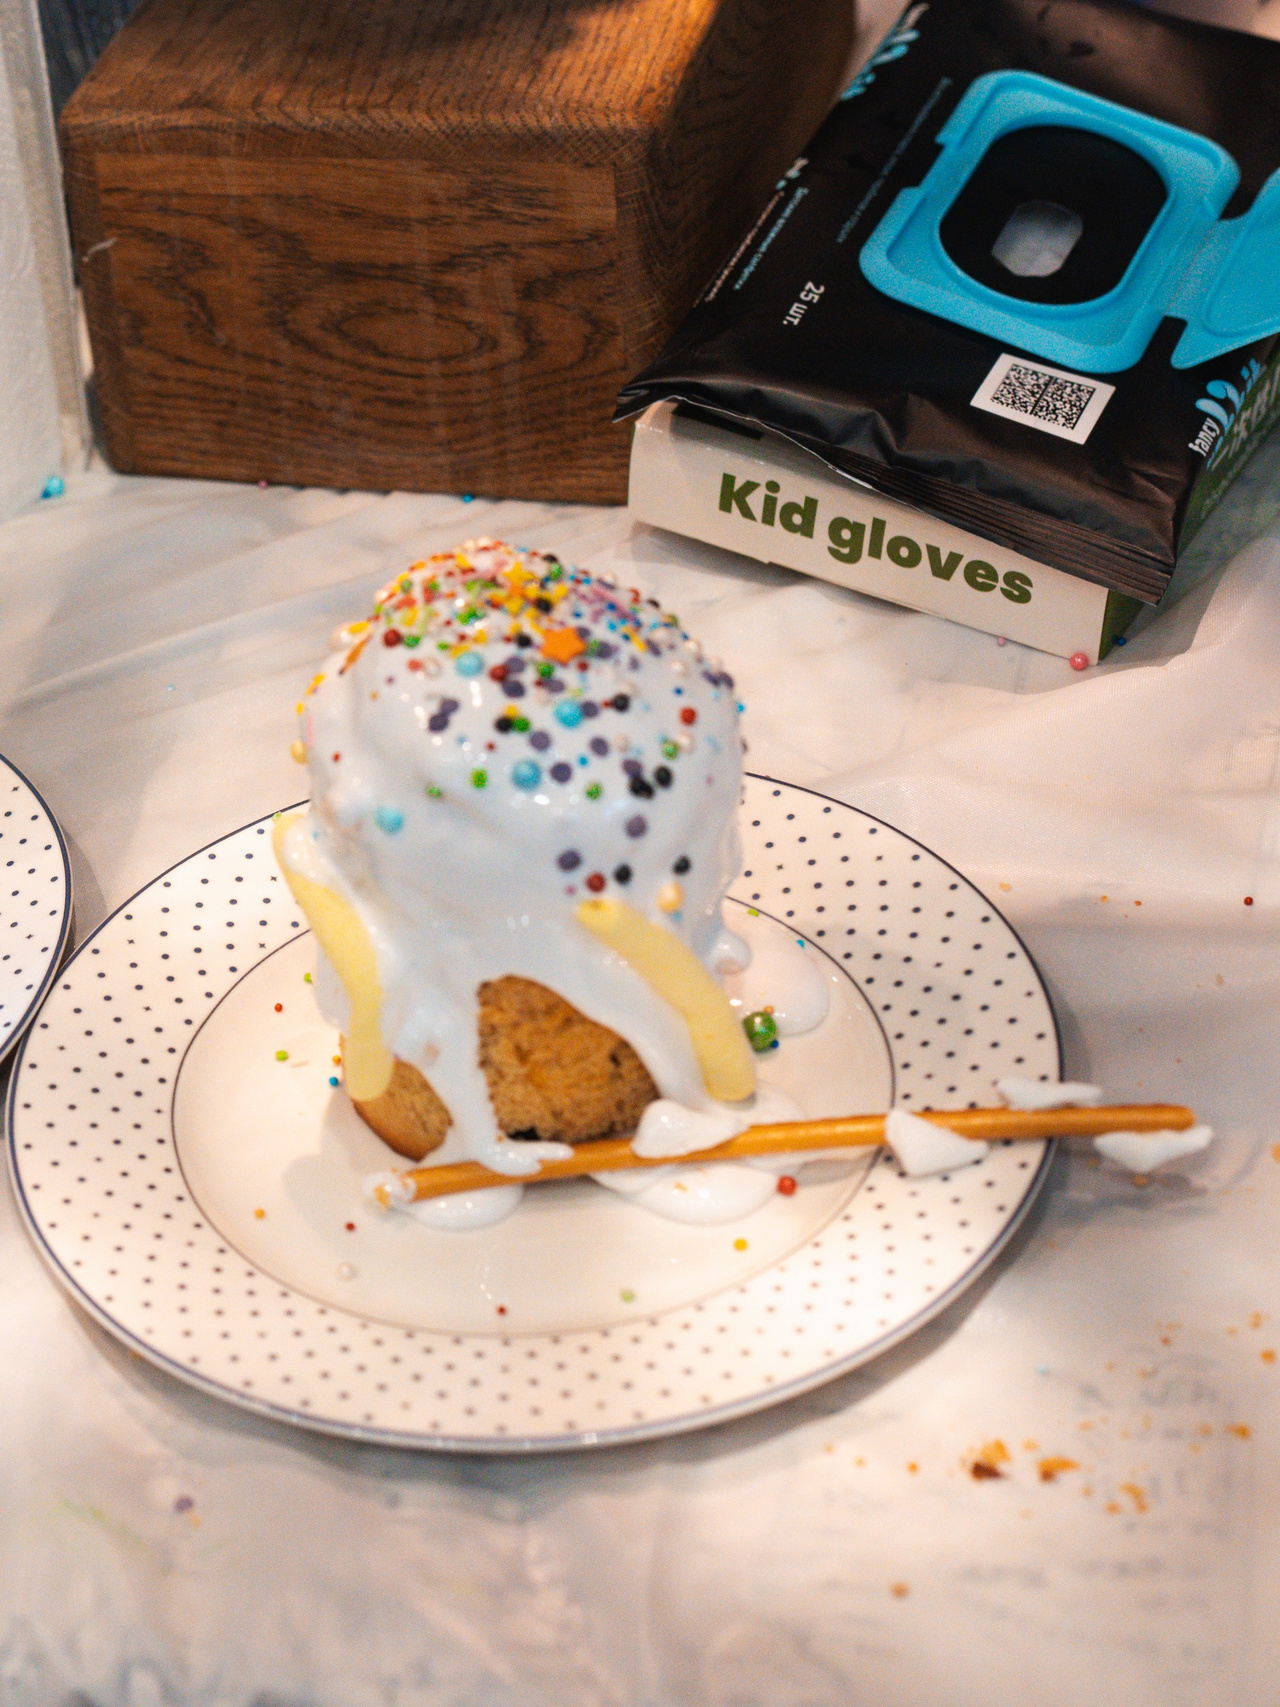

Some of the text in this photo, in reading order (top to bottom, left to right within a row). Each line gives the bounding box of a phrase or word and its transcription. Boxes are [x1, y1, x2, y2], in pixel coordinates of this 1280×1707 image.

[782, 281, 825, 325] 25 шт.
[1188, 417, 1220, 456] fancy
[718, 472, 1034, 604] Kid gloves
